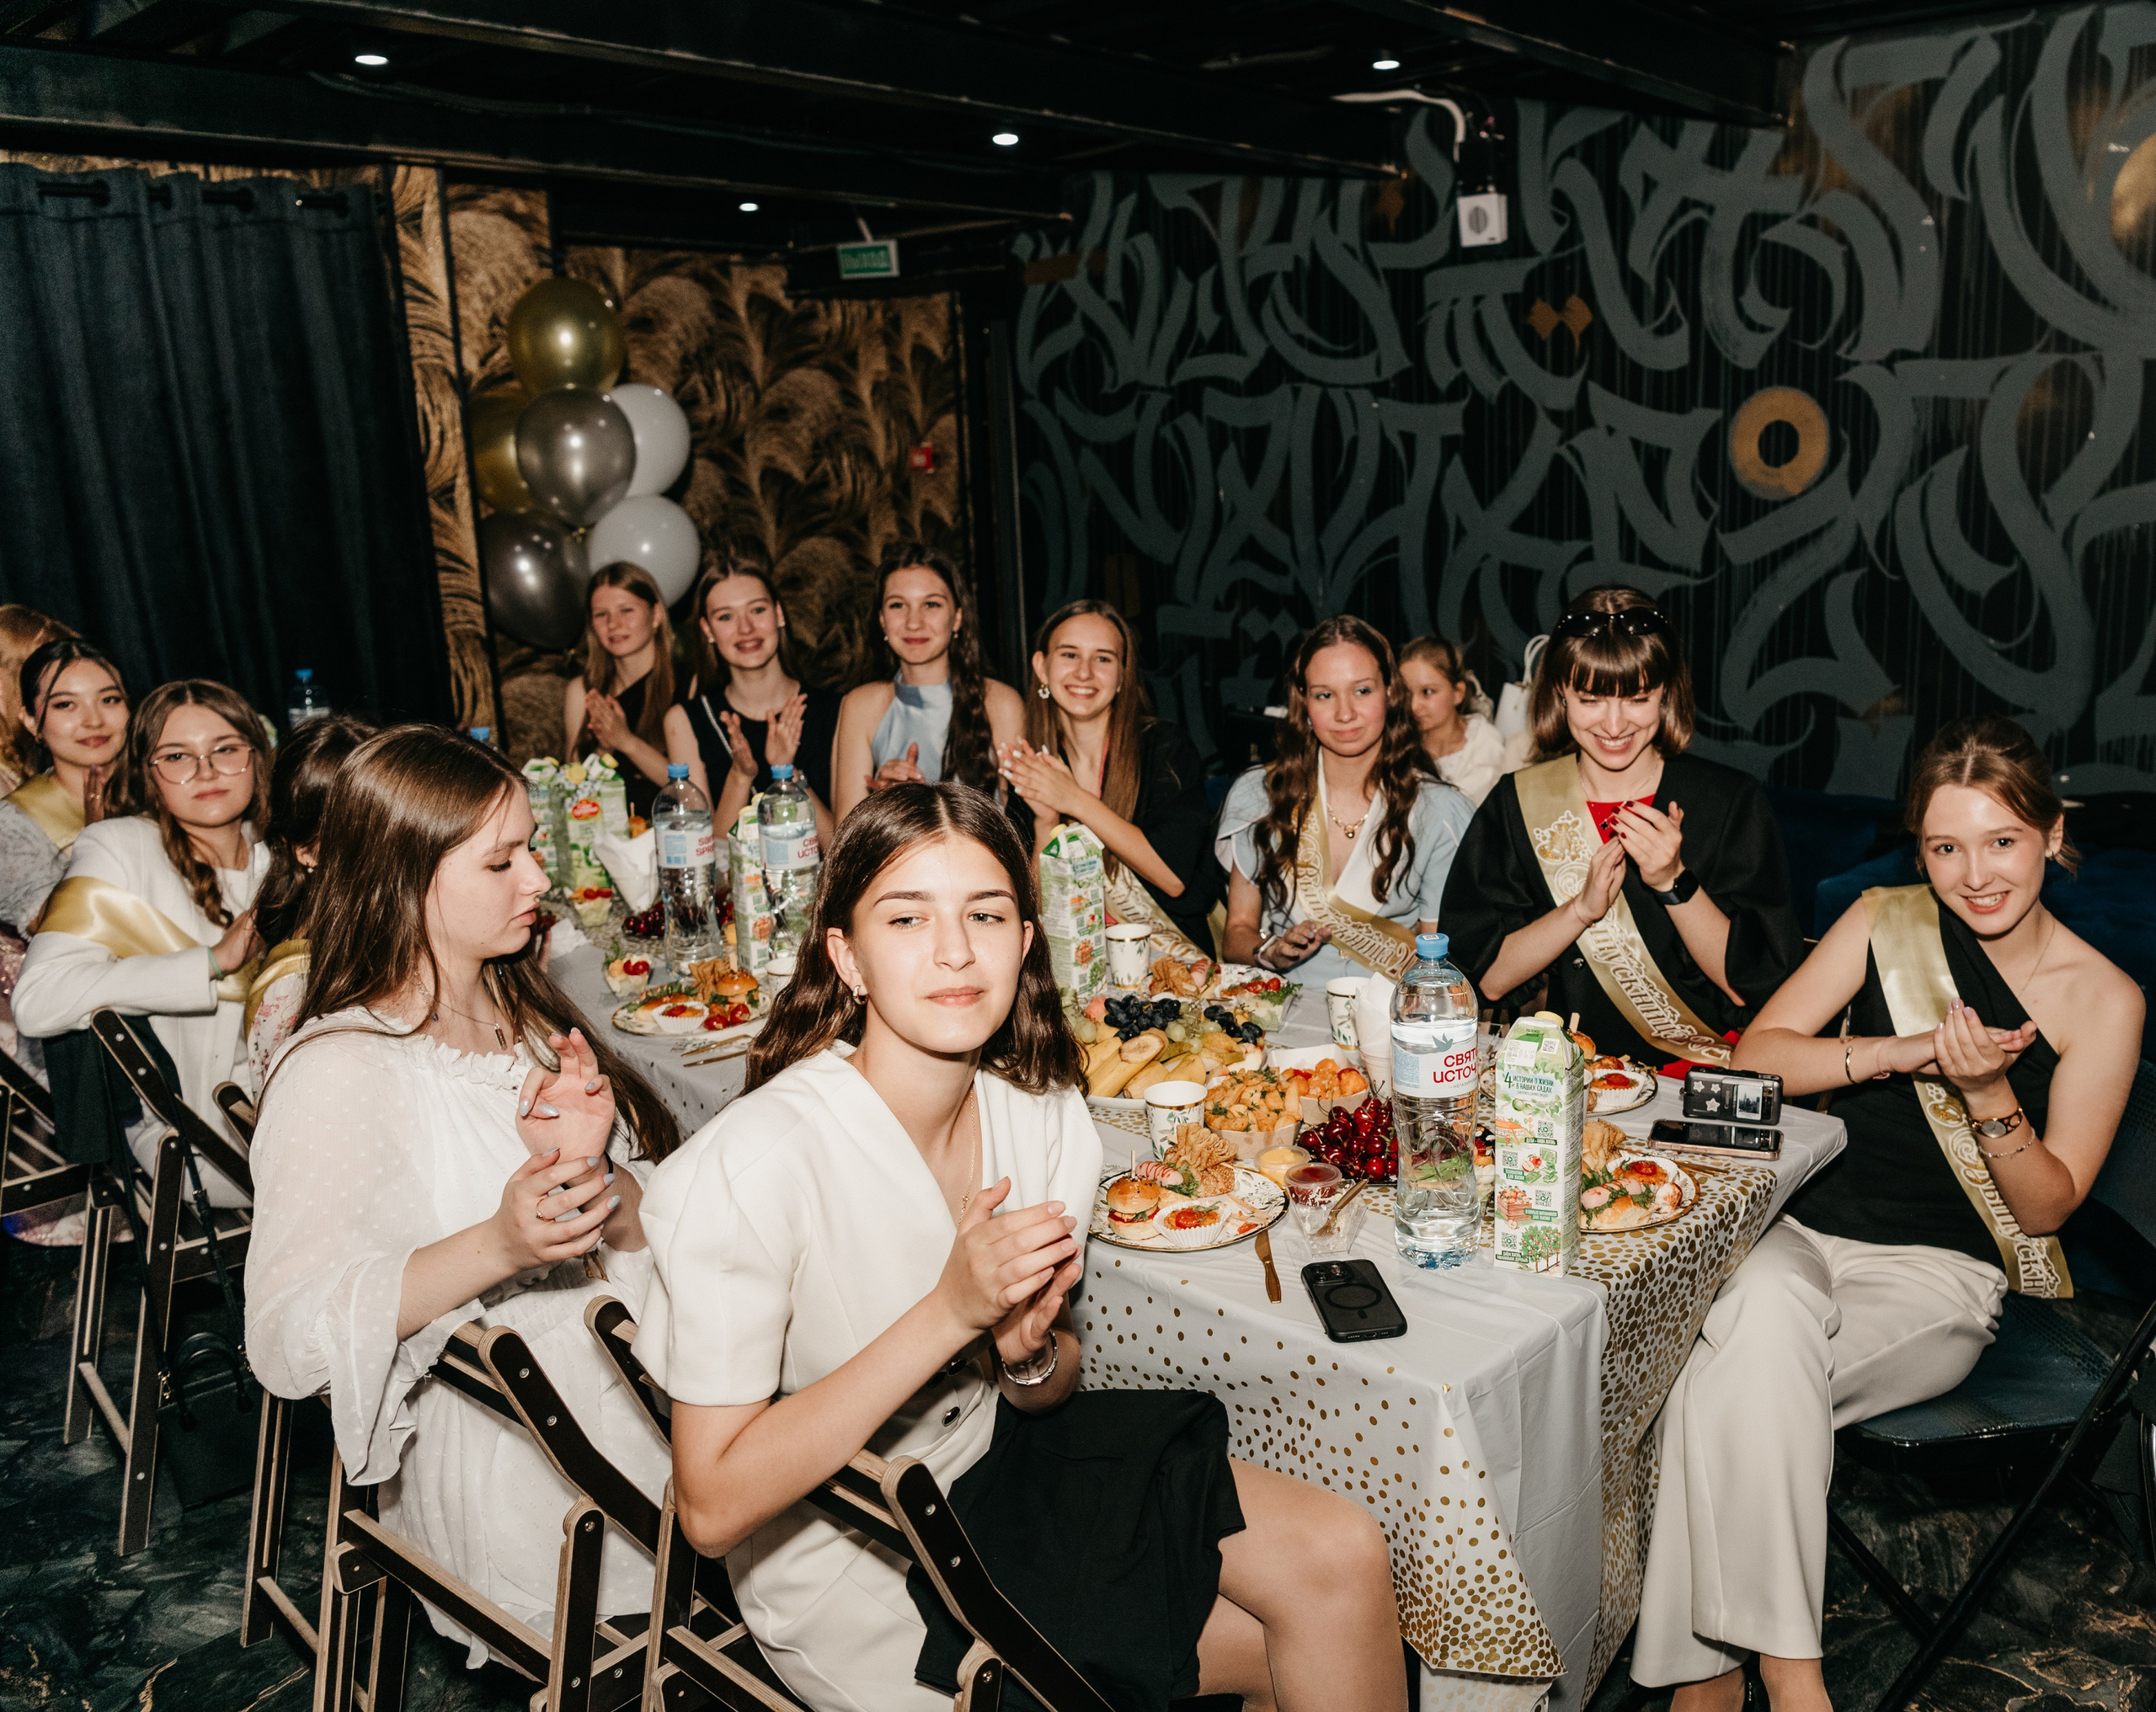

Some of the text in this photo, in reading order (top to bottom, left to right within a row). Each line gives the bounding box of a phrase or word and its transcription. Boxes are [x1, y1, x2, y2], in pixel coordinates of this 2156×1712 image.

[1444, 1047, 1477, 1068] СВЯТ
[1504, 1071, 1513, 1089] 4
[1513, 1075, 1534, 1085] ИСТОРИИ
[1537, 1085, 1553, 1093] САДАХ
